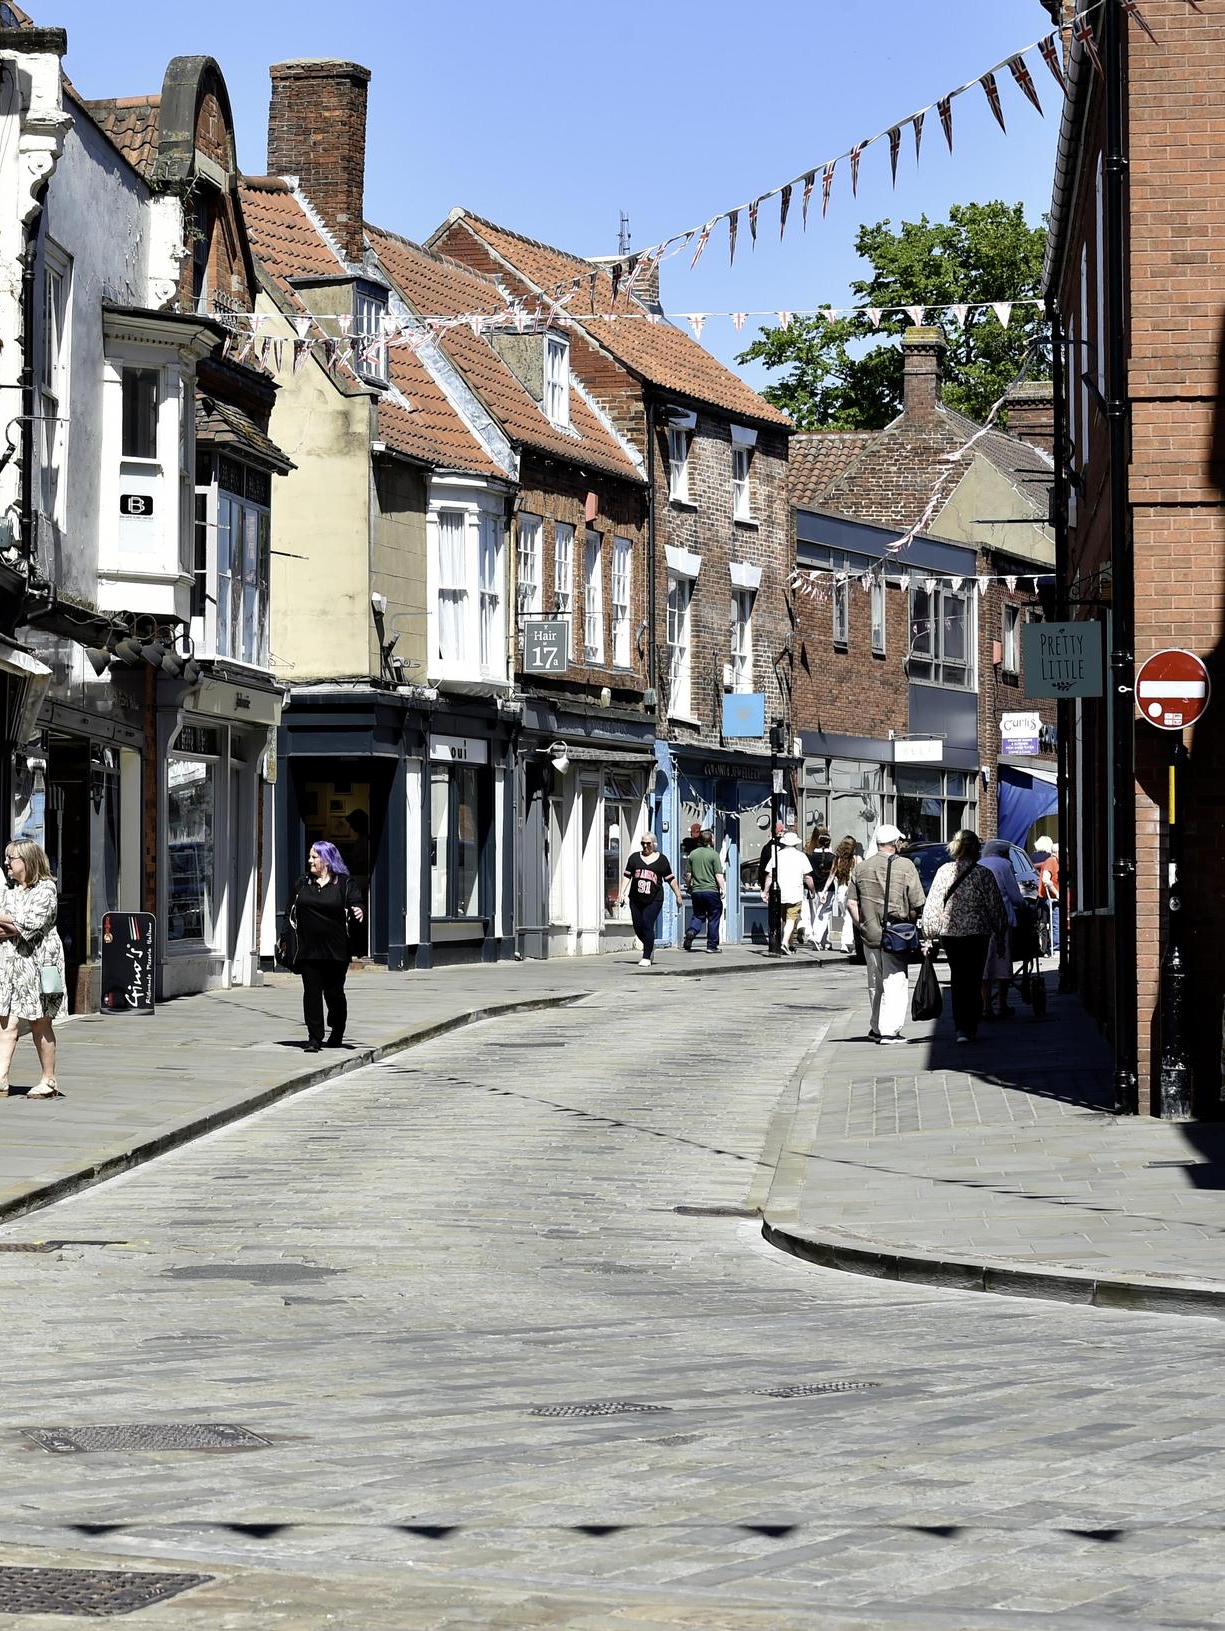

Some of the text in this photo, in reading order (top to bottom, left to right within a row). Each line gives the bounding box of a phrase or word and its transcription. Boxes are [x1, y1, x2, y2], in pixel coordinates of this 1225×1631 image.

[533, 629, 557, 642] Hair
[1040, 633, 1084, 656] PRETTY
[1041, 657, 1085, 681] LITTLE
[637, 879, 651, 894] 91
[125, 946, 145, 1008] Gino's
